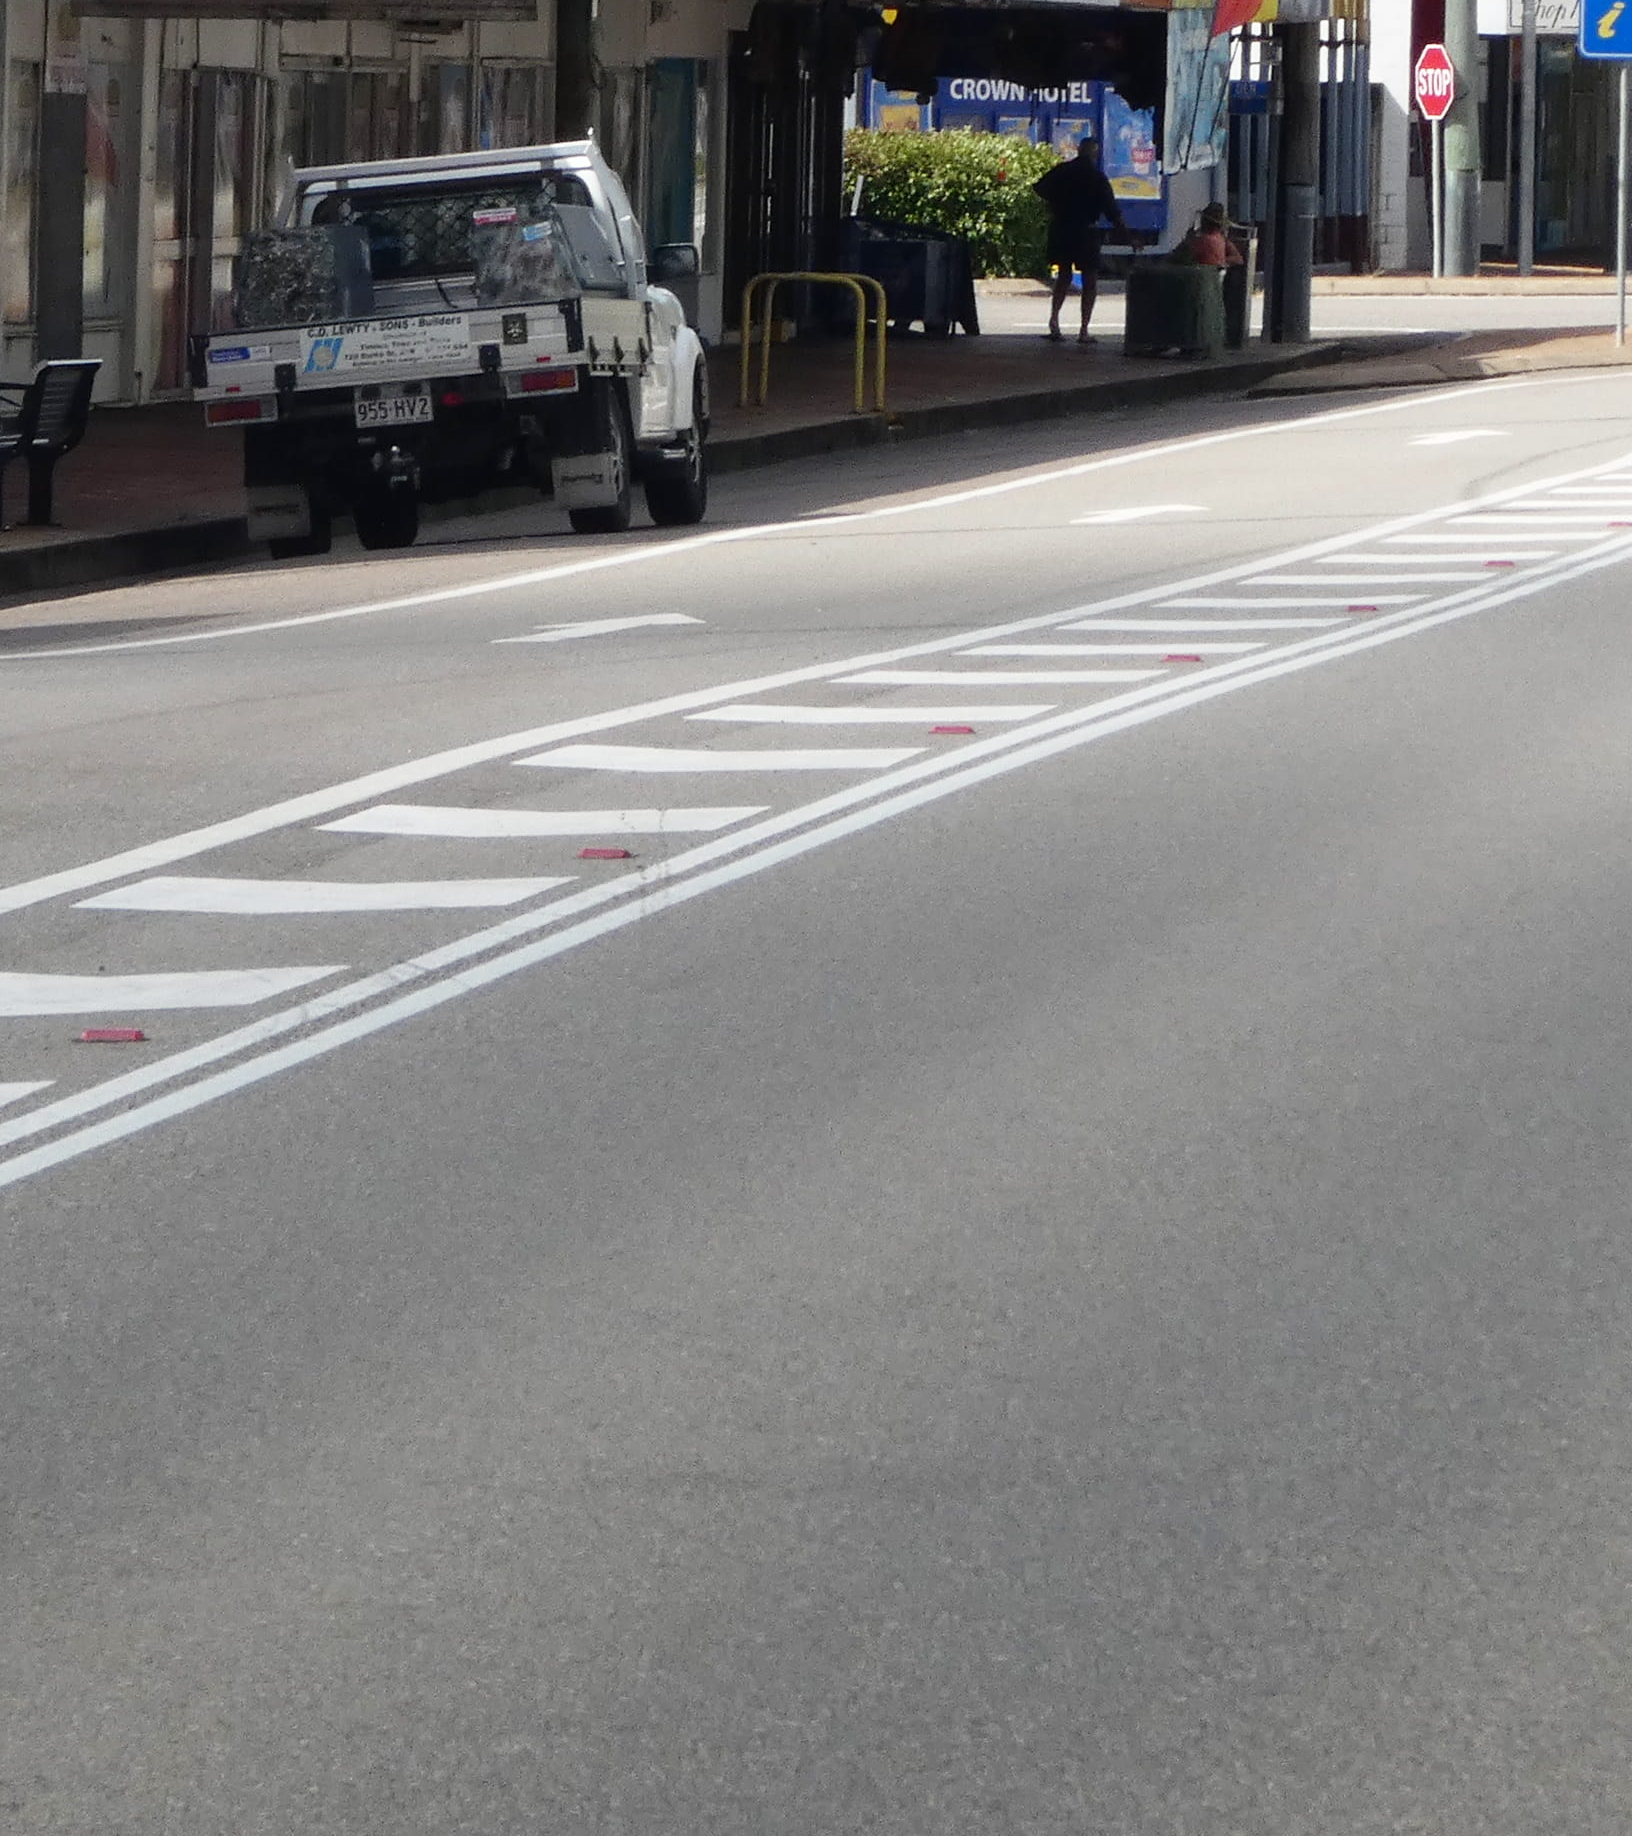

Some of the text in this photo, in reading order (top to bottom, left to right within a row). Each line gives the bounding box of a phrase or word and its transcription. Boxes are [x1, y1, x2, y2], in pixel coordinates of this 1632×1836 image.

[950, 78, 1024, 102] CROWN
[1419, 68, 1450, 96] STOP
[333, 322, 371, 336] LEWTY
[379, 320, 410, 332] SONS
[418, 315, 462, 328] Builders
